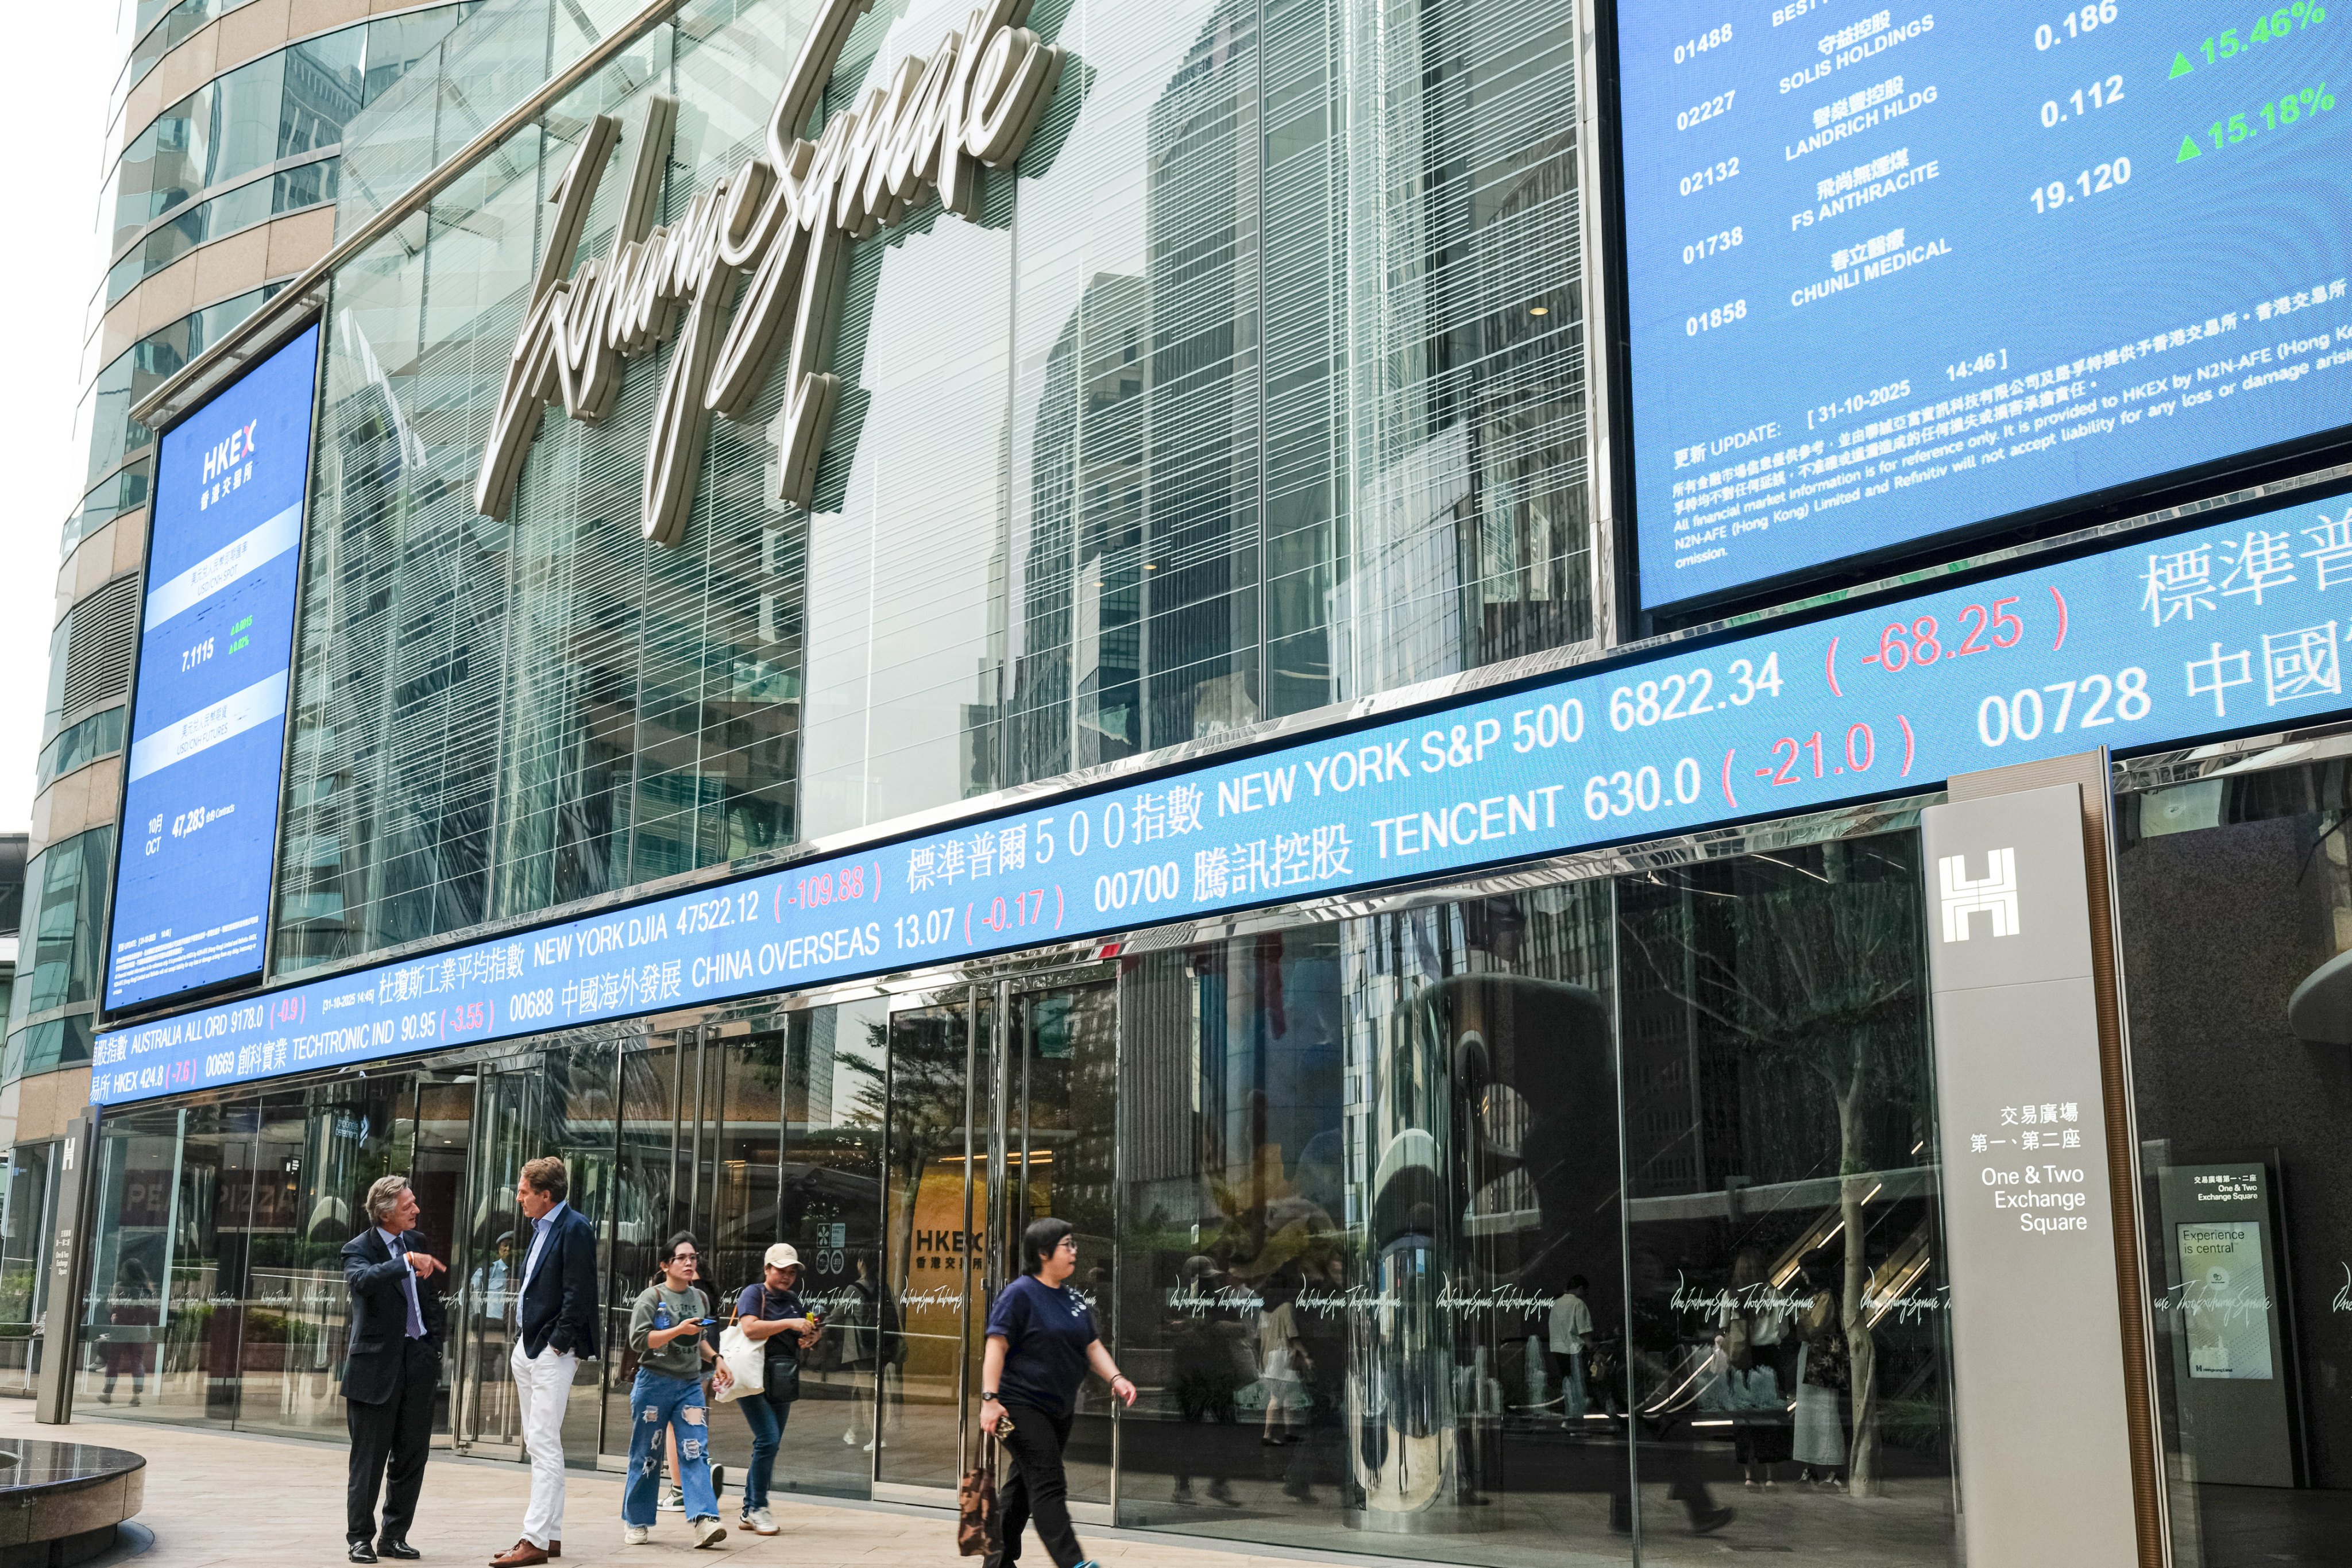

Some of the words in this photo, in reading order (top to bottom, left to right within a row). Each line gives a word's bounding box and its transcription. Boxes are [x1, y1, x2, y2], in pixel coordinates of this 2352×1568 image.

[1674, 23, 1733, 64] 01488
[2034, 0, 2118, 51] 0.186
[2200, 0, 2326, 64] 15.46%
[1779, 60, 1831, 94] SOLIS
[1836, 14, 1934, 69] HOLDINGS
[1677, 90, 1736, 131] 02227
[2041, 75, 2125, 128] 0.112
[2208, 82, 2335, 149] 15.18%
[1785, 111, 1878, 161] LANDRICH
[1884, 86, 1937, 120] HLDG
[1680, 157, 1740, 196] 02132
[1792, 210, 1814, 231] FS
[1818, 160, 1940, 221] ANTHRACITE
[2030, 157, 2131, 214] 19.120
[1683, 226, 1743, 264] 01738
[1791, 273, 1859, 306] CHUNLI
[1864, 238, 1952, 281] MEDICAL
[1686, 300, 1747, 336] 01858
[203, 418, 257, 485] HKEX
[1674, 521, 1690, 532] All
[1694, 503, 1740, 527] financial
[1744, 493, 1786, 512] market
[1790, 472, 1860, 500] information
[1865, 466, 1875, 477] is
[1879, 461, 1897, 475] for
[1902, 442, 1963, 467] reference
[1968, 430, 1999, 448] only.
[2004, 425, 2013, 437] It
[2019, 422, 2030, 433] is
[2034, 399, 2096, 430] provided
[2103, 395, 2118, 407] to
[2123, 377, 2168, 403] HKEX
[2173, 373, 2191, 390] by
[2197, 348, 2272, 381] N2N-AFE
[2277, 333, 2330, 360] (Hong
[1674, 443, 1707, 470] 更新
[1710, 422, 1781, 455] UPDATE:
[1675, 526, 1727, 551] N2N-AFE
[1732, 513, 1769, 536] (Hong
[1774, 503, 1809, 524] Kong)
[1814, 490, 1860, 512] Limited
[1865, 480, 1889, 497] and
[1895, 465, 1947, 489] Refinitiv
[1953, 455, 1976, 473] will
[1982, 448, 2005, 465] not
[2010, 434, 2057, 457] accept
[2062, 416, 2115, 442] liability
[2121, 410, 2142, 425] for
[2148, 400, 2176, 416] any
[2183, 389, 2212, 407] loss
[2218, 383, 2236, 398] or
[2242, 362, 2309, 391] damage
[200, 461, 253, 511] 香港交易所
[223, 564, 238, 586] SPOT
[1675, 548, 1727, 569] omission.
[181, 636, 215, 673] 7.1115
[203, 723, 228, 742] FUTURES
[149, 813, 163, 834] 10月
[172, 806, 205, 839] 47,283
[215, 804, 235, 818] Contracts
[131, 1025, 181, 1055] AUSTRALIA
[184, 1020, 202, 1043] ALL
[205, 1014, 227, 1038] ORD
[231, 1005, 263, 1033] 9178.0
[534, 936, 573, 968] NEW
[576, 920, 624, 957] YORK
[628, 912, 667, 949] DJIA
[677, 890, 759, 937] 47522.12
[1216, 765, 1301, 818] NEW
[1306, 738, 1412, 798] YORK
[1420, 718, 1501, 774] S&P
[1513, 698, 1584, 754] 500
[1609, 649, 1785, 733] 6822.34
[146, 836, 161, 856] OCT
[113, 1070, 138, 1093] HKEX
[140, 1065, 164, 1089] 424.8
[206, 1051, 234, 1077] 00669
[237, 1037, 288, 1076] 創科實業
[292, 1024, 370, 1061] TECHTRONIC
[372, 1019, 395, 1046] IND
[401, 1011, 436, 1041] 90.95
[509, 988, 554, 1022] 00688
[561, 959, 682, 1018] 中國海外發展
[692, 948, 753, 988] CHINA
[758, 921, 880, 976] OVERSEAS
[894, 907, 954, 951] 13.07
[1094, 862, 1180, 914] 00700
[1193, 822, 1354, 905] 騰訊控股
[1370, 784, 1565, 860] TENCENT
[1584, 755, 1702, 821] 630.0
[1976, 665, 2152, 748] 00728
[1969, 1128, 2081, 1153] 第一、第二座
[1982, 1167, 2019, 1185] One
[2025, 1165, 2041, 1184] &
[2044, 1165, 2084, 1183] Two
[1995, 1189, 2085, 1211] Exchange
[2198, 1194, 2231, 1202] Exchange
[2233, 1192, 2258, 1200] Square
[2020, 1214, 2087, 1234] Square
[2183, 1230, 2245, 1242] Experience
[2184, 1243, 2193, 1253] is
[2197, 1242, 2234, 1253] central
